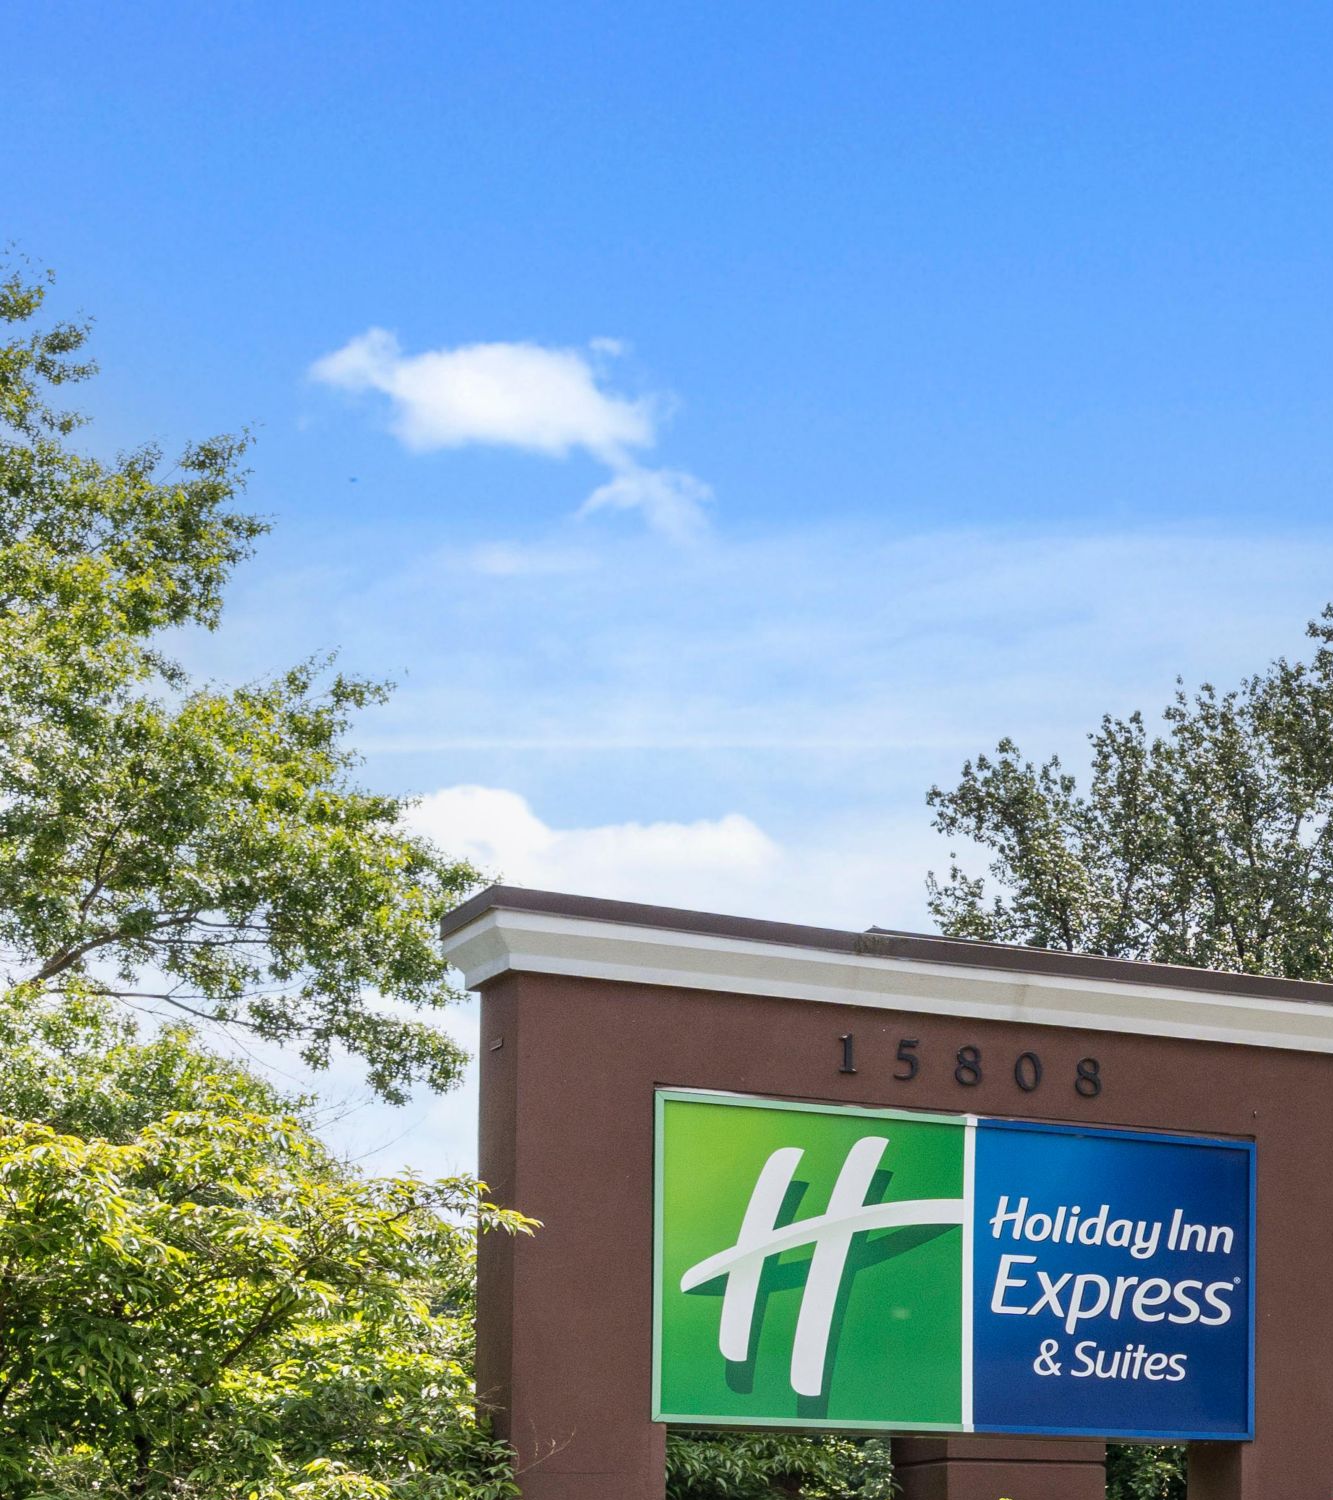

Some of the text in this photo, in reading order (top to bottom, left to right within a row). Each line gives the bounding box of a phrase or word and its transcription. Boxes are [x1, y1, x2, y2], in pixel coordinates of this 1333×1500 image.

[838, 1033, 1102, 1098] 15808
[989, 1195, 1234, 1259] Holiday Inn
[1033, 1338, 1188, 1381] & Suites
